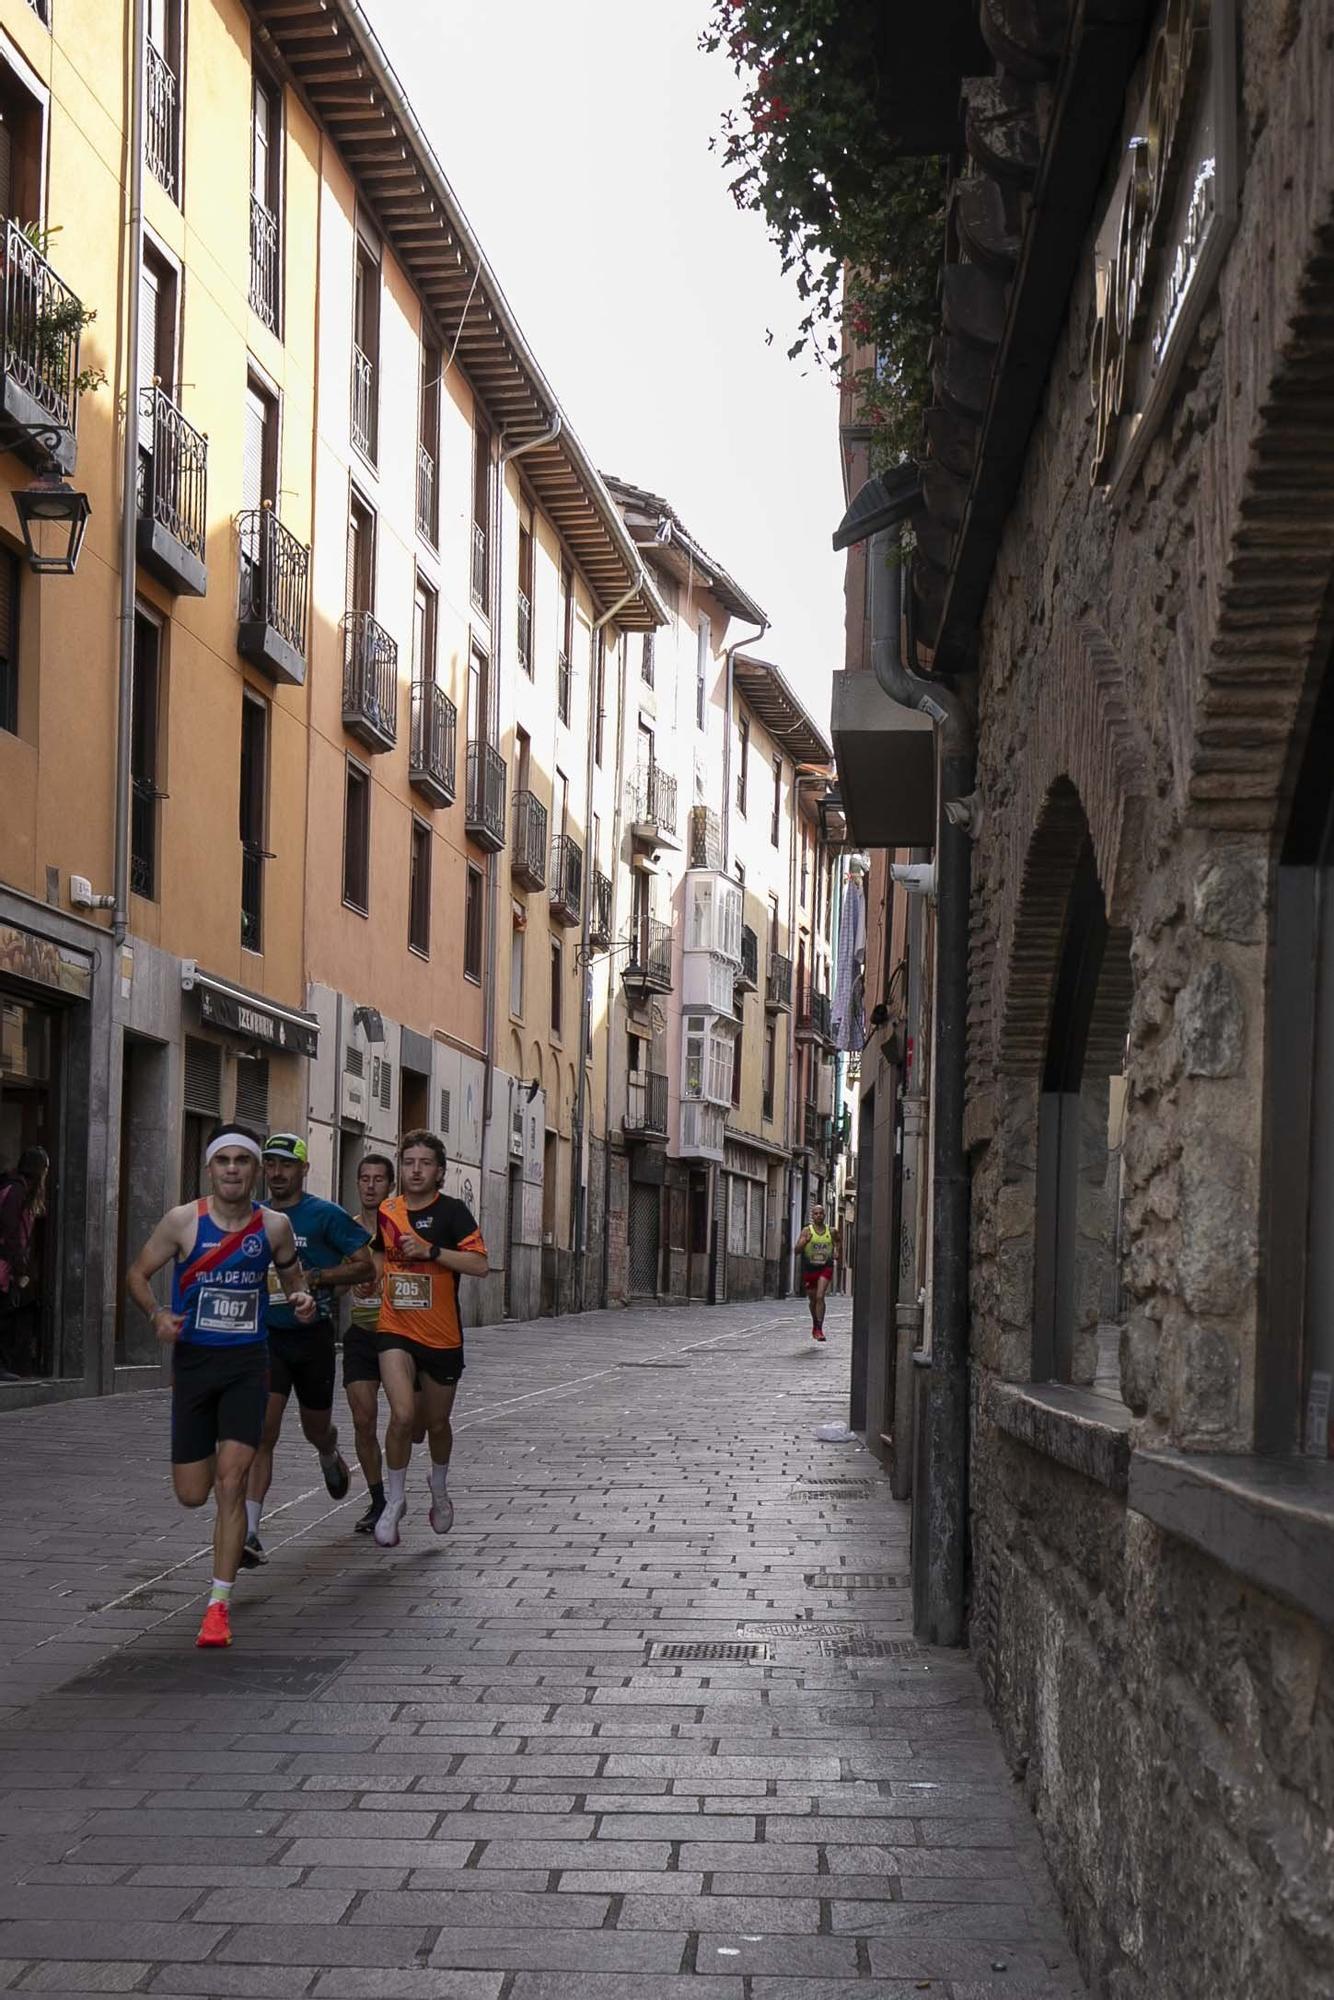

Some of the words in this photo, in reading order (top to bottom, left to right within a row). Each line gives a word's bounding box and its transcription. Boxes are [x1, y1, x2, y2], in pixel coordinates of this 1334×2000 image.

[195, 1270, 223, 1284] VILLA
[225, 1271, 240, 1284] DE
[395, 1281, 419, 1296] 205
[212, 1299, 248, 1317] 1067
